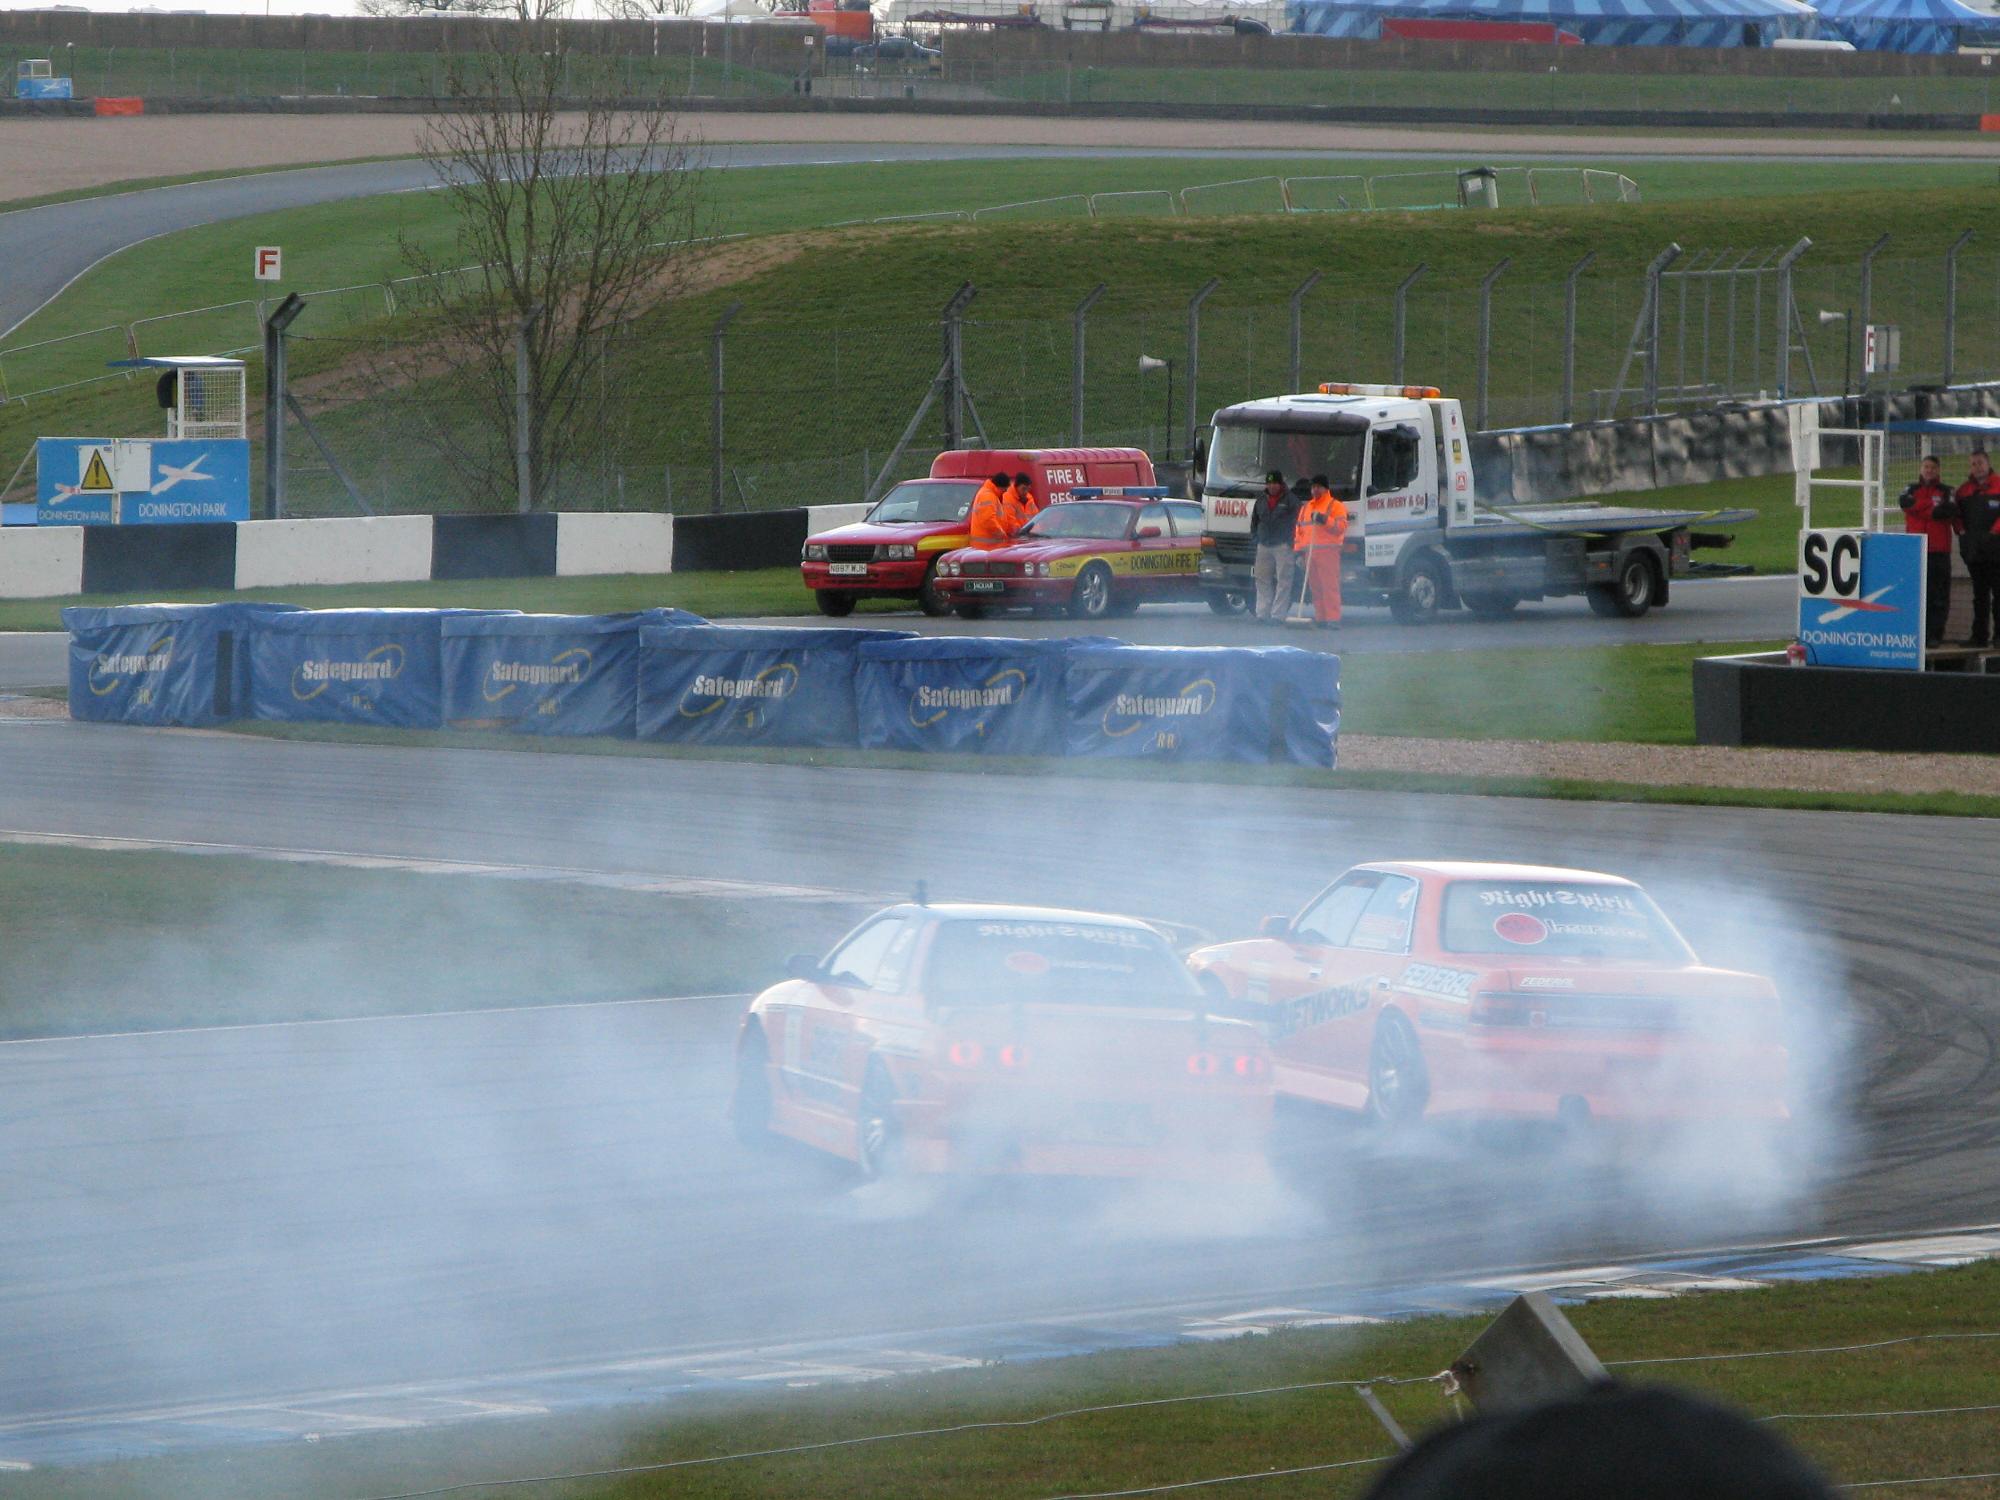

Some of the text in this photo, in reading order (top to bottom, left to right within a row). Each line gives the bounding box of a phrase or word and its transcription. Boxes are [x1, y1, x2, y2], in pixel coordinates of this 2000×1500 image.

[260, 250, 278, 275] F
[1046, 469, 1085, 484] FIRE &
[38, 510, 111, 522] DONINGTON PARK
[139, 503, 227, 517] DONINGTON PARK
[1214, 499, 1248, 518] MICK
[1131, 553, 1174, 570] DONINGTON
[1175, 552, 1192, 569] FIRE
[1803, 533, 1859, 596] SC
[1803, 631, 1917, 648] DONINGTON PARK
[98, 653, 170, 675] Safeguard
[303, 660, 393, 681] Safeguard
[492, 661, 580, 684] Safeguard
[693, 675, 785, 699] Safeguard
[918, 684, 1013, 710] Safeguard
[1116, 694, 1203, 718] Safeguard
[1403, 962, 1479, 997] FEDERAL
